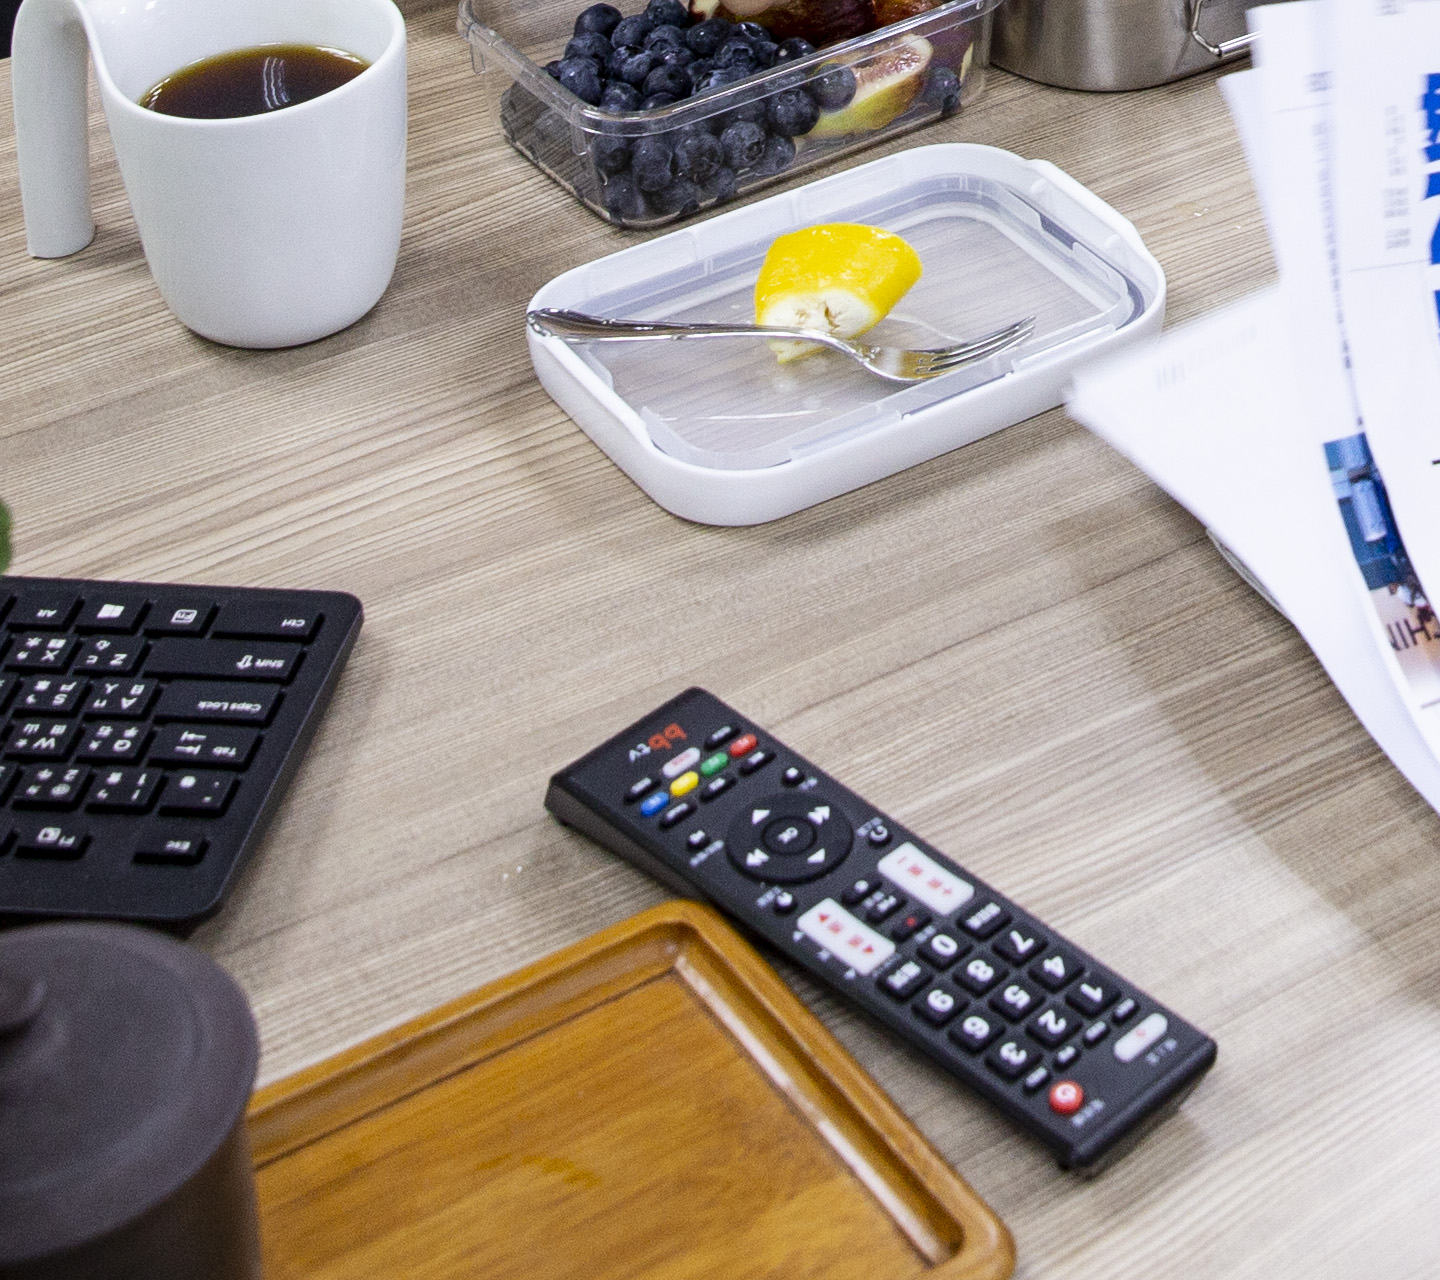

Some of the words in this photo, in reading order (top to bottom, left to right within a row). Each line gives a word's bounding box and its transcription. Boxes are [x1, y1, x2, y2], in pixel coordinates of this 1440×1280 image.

[282, 619, 305, 627] Ctrl
[198, 701, 231, 710] Lock
[230, 703, 261, 712] Caps
[167, 841, 190, 851] Esc
[932, 935, 957, 955] 0
[1011, 931, 1034, 952] 7
[968, 960, 993, 981] 8
[1044, 957, 1064, 976] 4
[928, 990, 953, 1011] 9
[1004, 986, 1030, 1008] 5
[1081, 984, 1102, 1001] 1
[964, 1017, 989, 1038] 6
[1039, 1010, 1066, 1033] 2
[1001, 1043, 1026, 1064] 3
